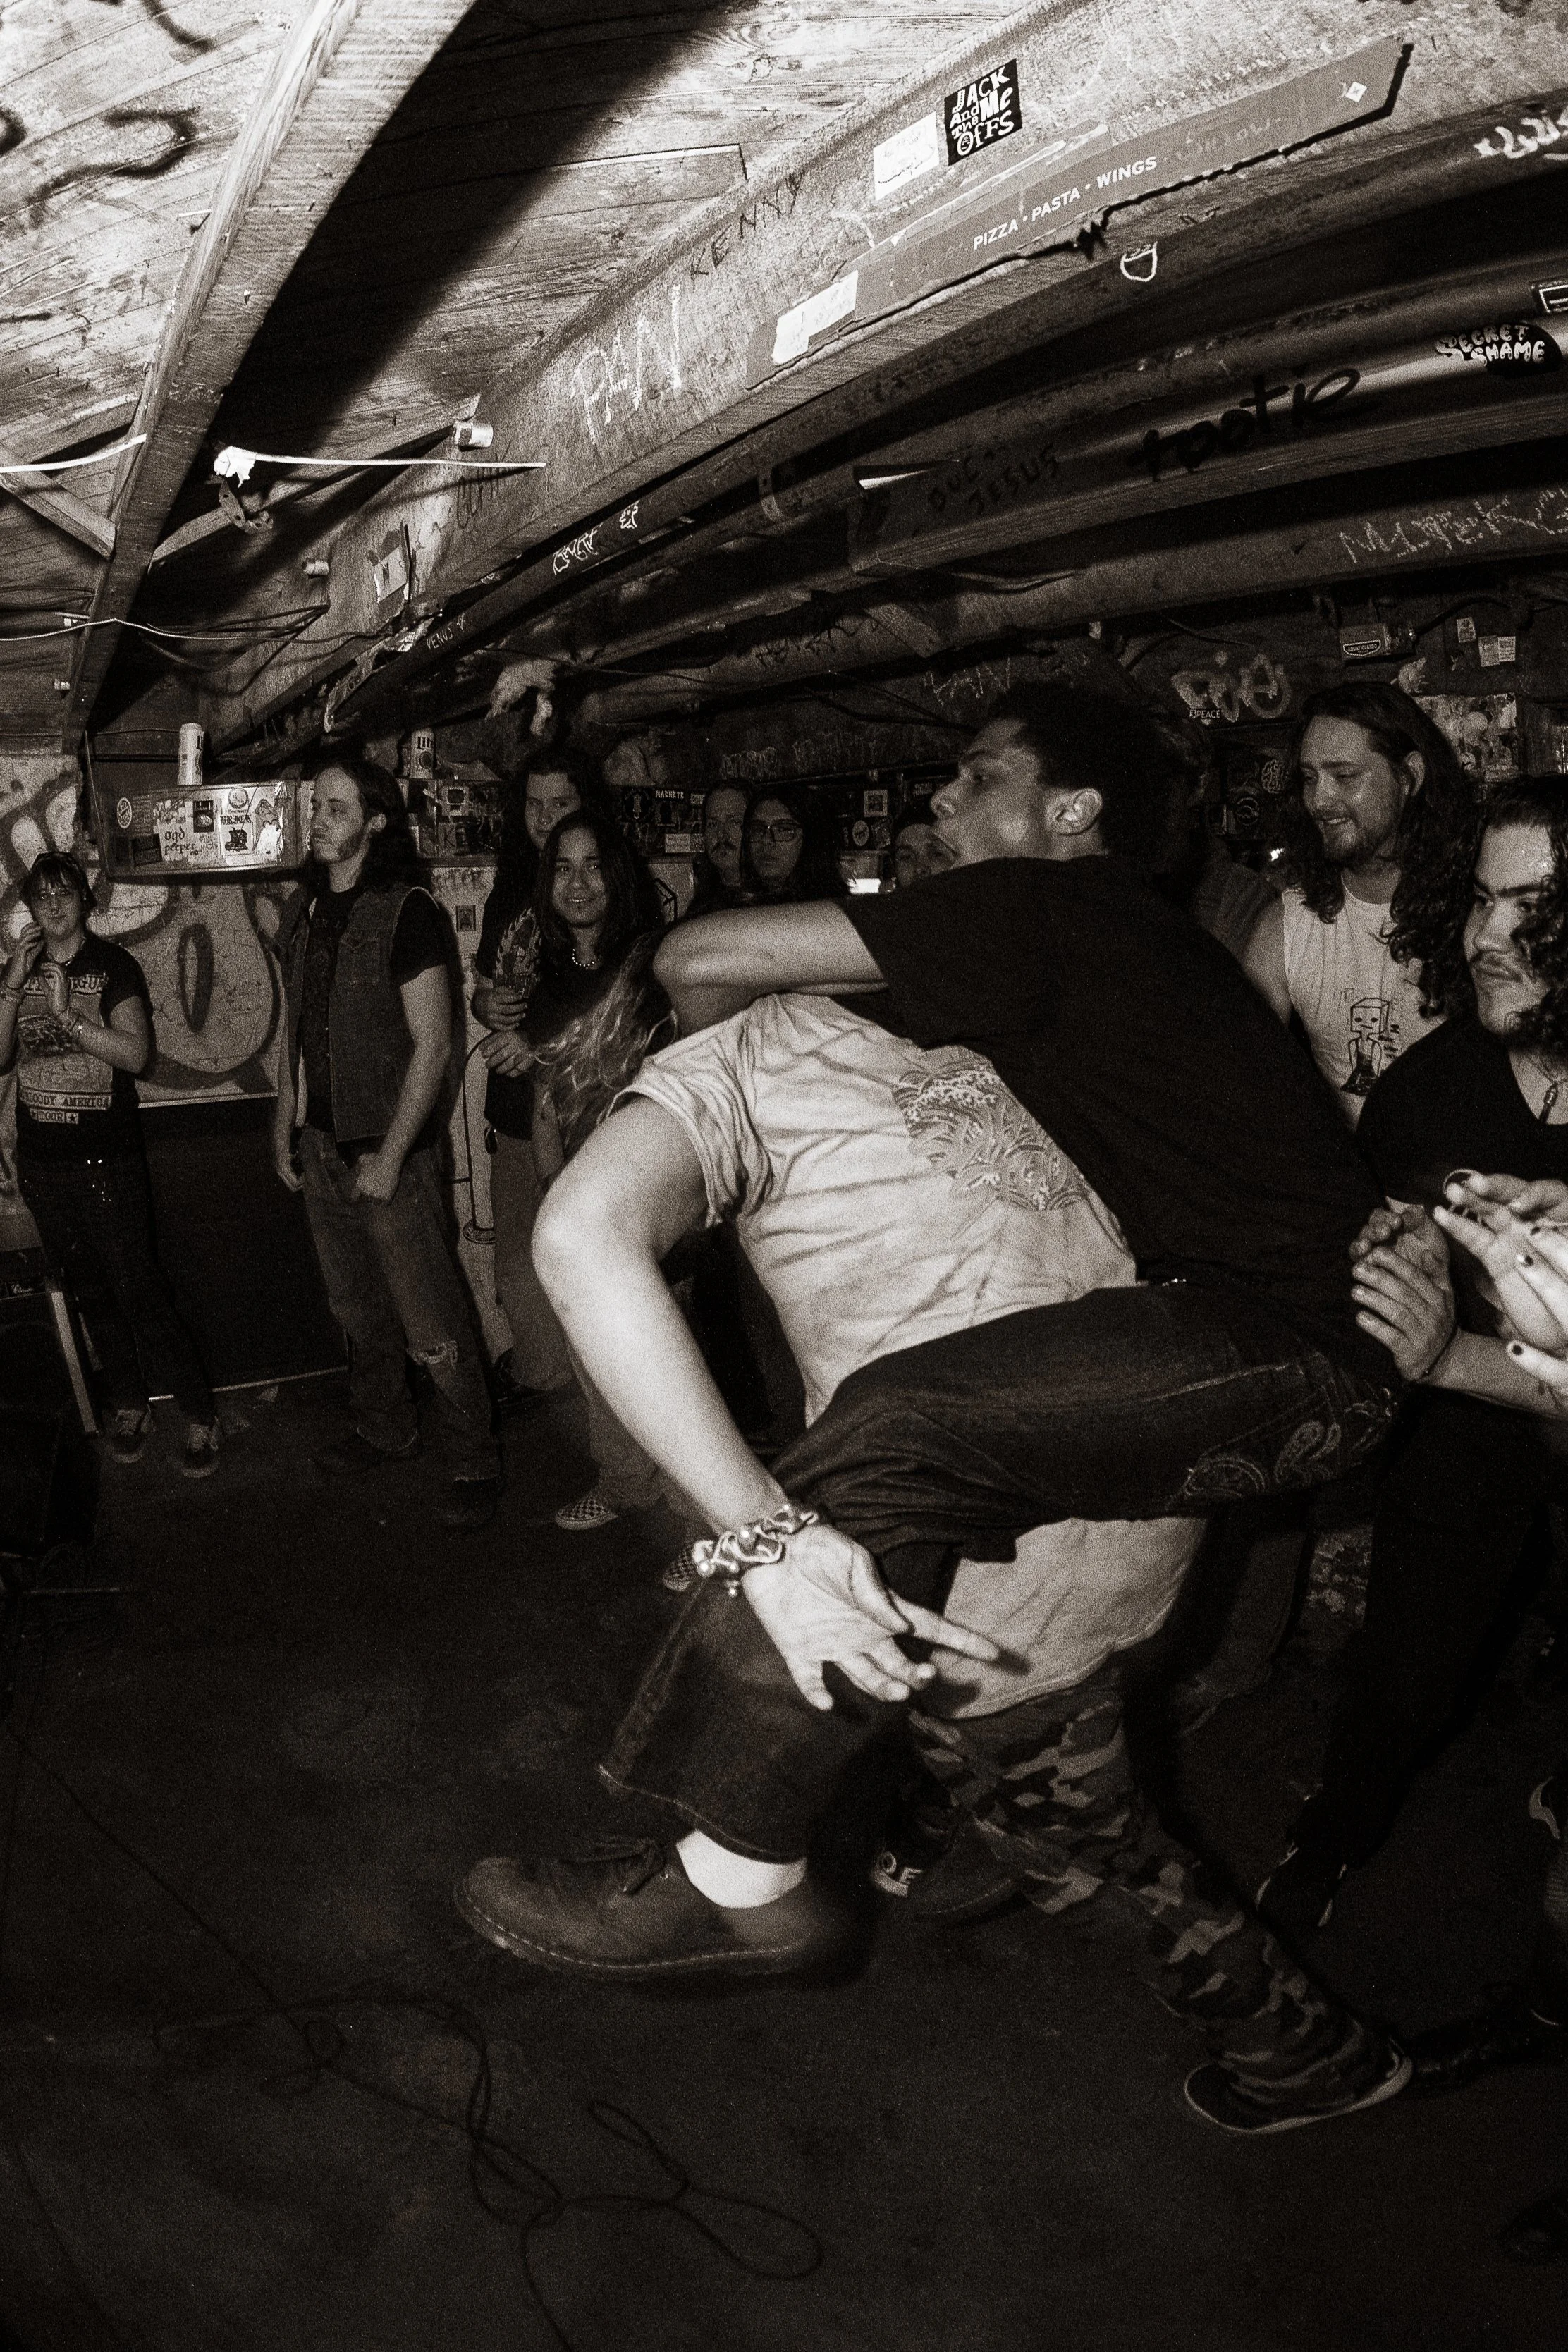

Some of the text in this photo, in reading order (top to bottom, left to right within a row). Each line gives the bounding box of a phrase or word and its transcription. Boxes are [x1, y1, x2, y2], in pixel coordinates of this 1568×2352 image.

[951, 66, 1010, 114] JACK
[979, 87, 1014, 122] Me
[973, 156, 1157, 250] PIZZA PASTA WINGS
[1471, 341, 1545, 367] SHAME
[426, 621, 453, 649] VENUS
[220, 814, 253, 826] BRICK
[38, 1110, 64, 1122] TOUR
